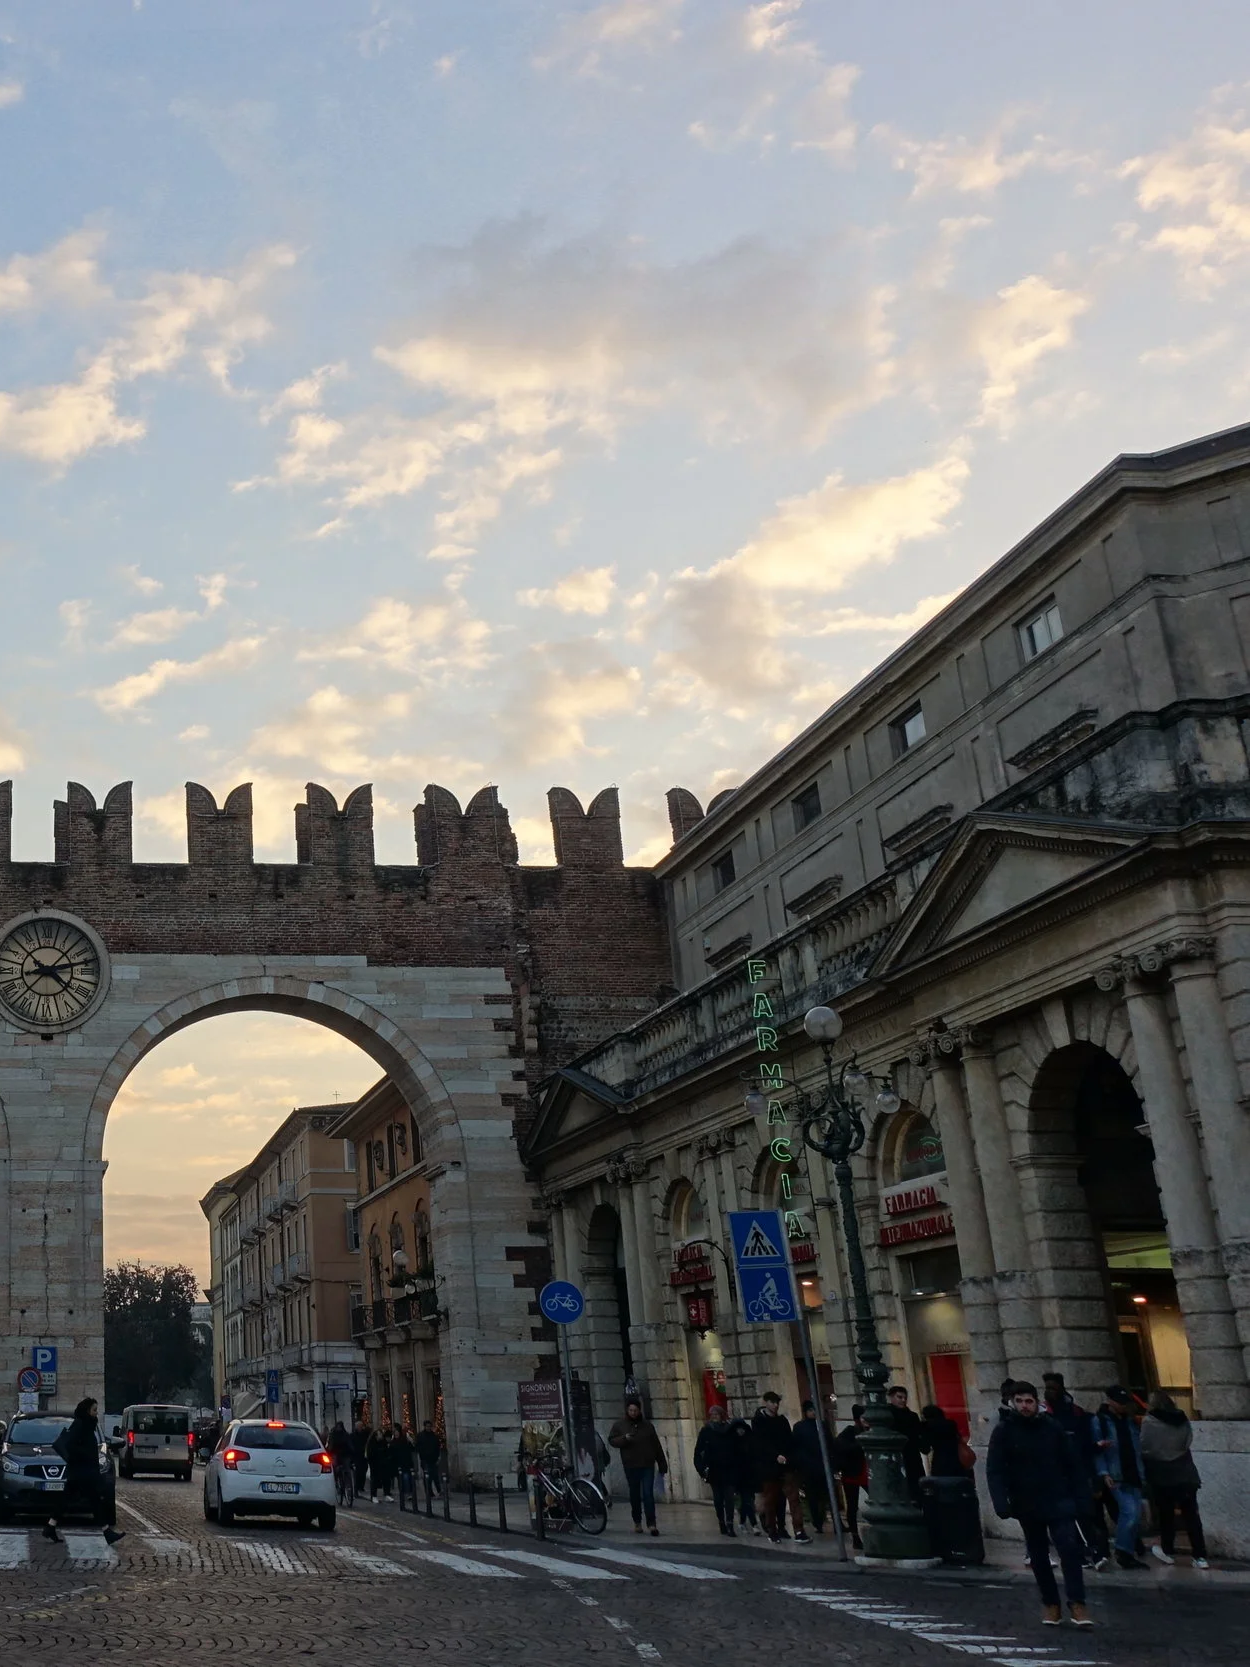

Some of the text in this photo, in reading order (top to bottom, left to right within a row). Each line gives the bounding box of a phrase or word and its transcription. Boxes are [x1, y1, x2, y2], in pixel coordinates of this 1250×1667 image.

[42, 925, 53, 938] XII
[0, 967, 13, 975] IX
[81, 967, 94, 976] III
[747, 959, 805, 1238] FARMACIA
[885, 1186, 937, 1213] FARMACIA
[37, 1349, 52, 1370] P
[520, 1383, 557, 1393] SIGNORVINO
